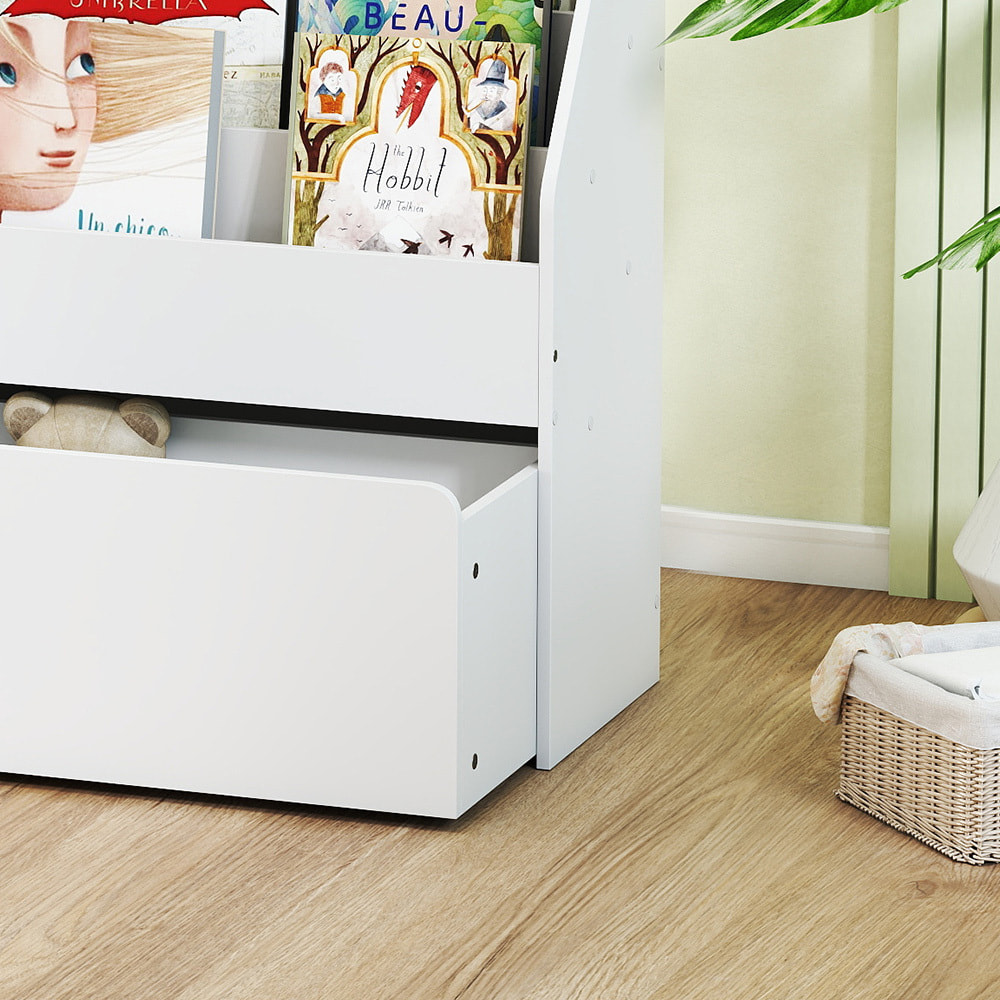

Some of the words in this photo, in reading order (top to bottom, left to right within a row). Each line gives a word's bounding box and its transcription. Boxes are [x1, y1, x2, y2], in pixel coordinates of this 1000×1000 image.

[364, 1, 488, 35] BEAU-
[362, 141, 447, 198] Hobbit
[396, 200, 424, 213] Tolkien
